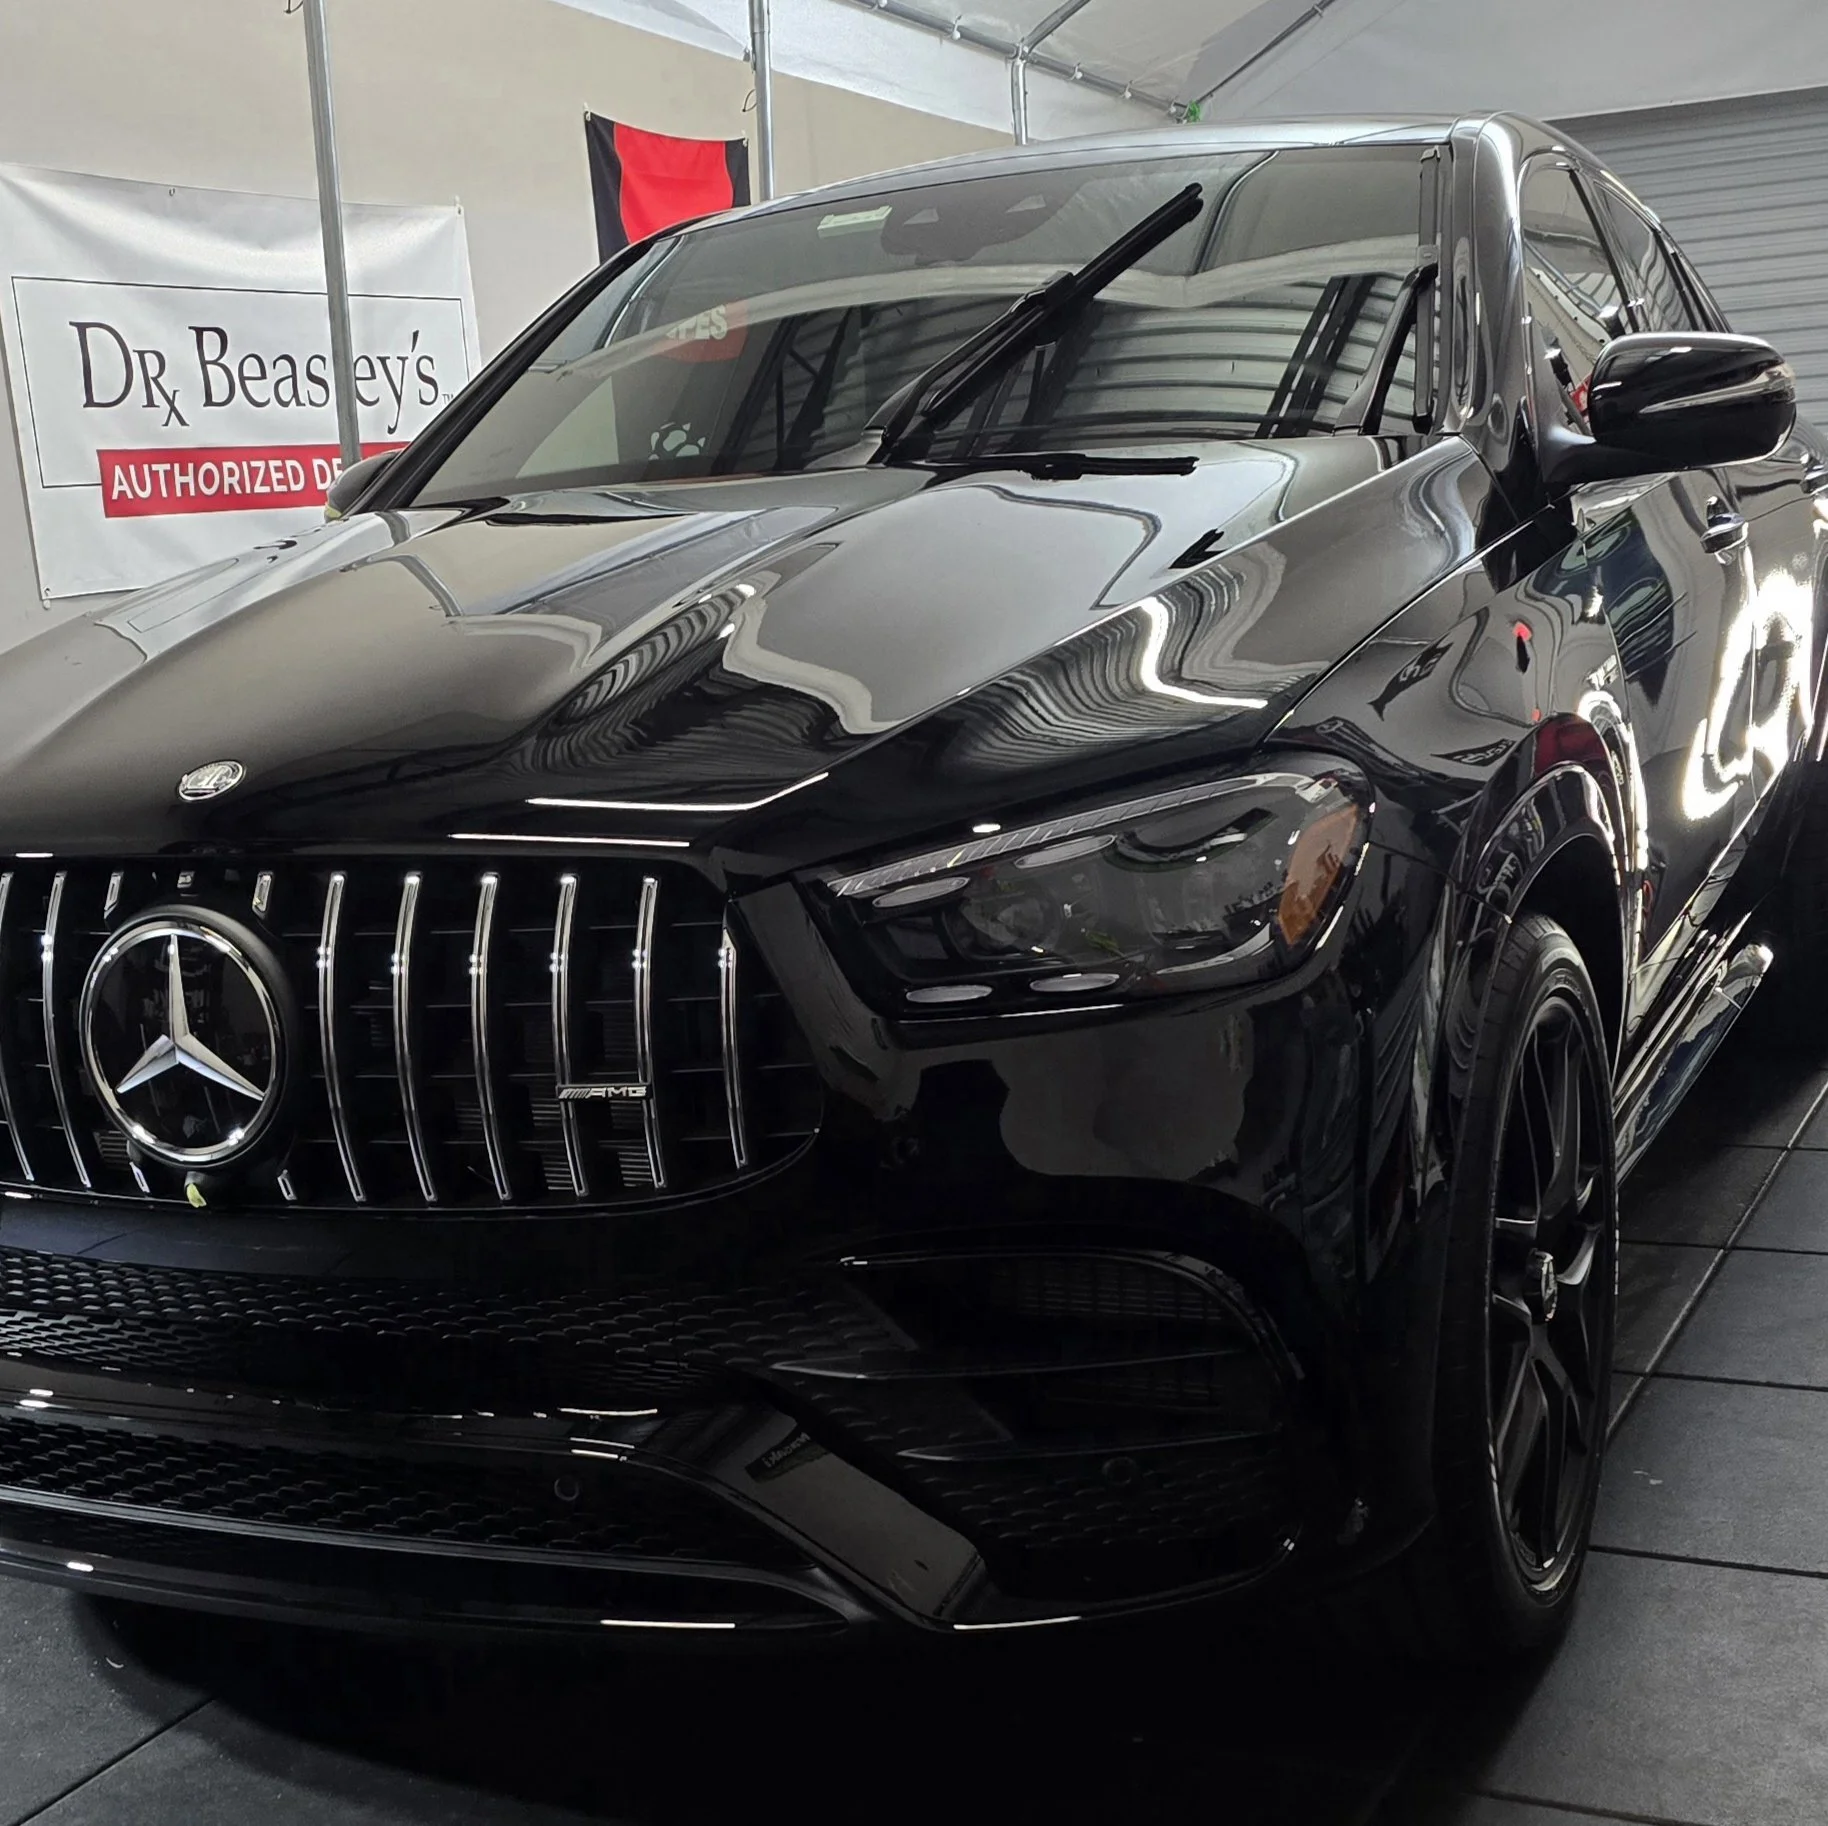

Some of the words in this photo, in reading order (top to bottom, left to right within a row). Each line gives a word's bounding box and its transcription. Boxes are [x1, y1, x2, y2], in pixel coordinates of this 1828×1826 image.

[188, 326, 439, 435] Beasey's
[112, 459, 305, 500] AUTHORIZED
[312, 457, 343, 490] DE
[586, 1086, 646, 1099] AMG
